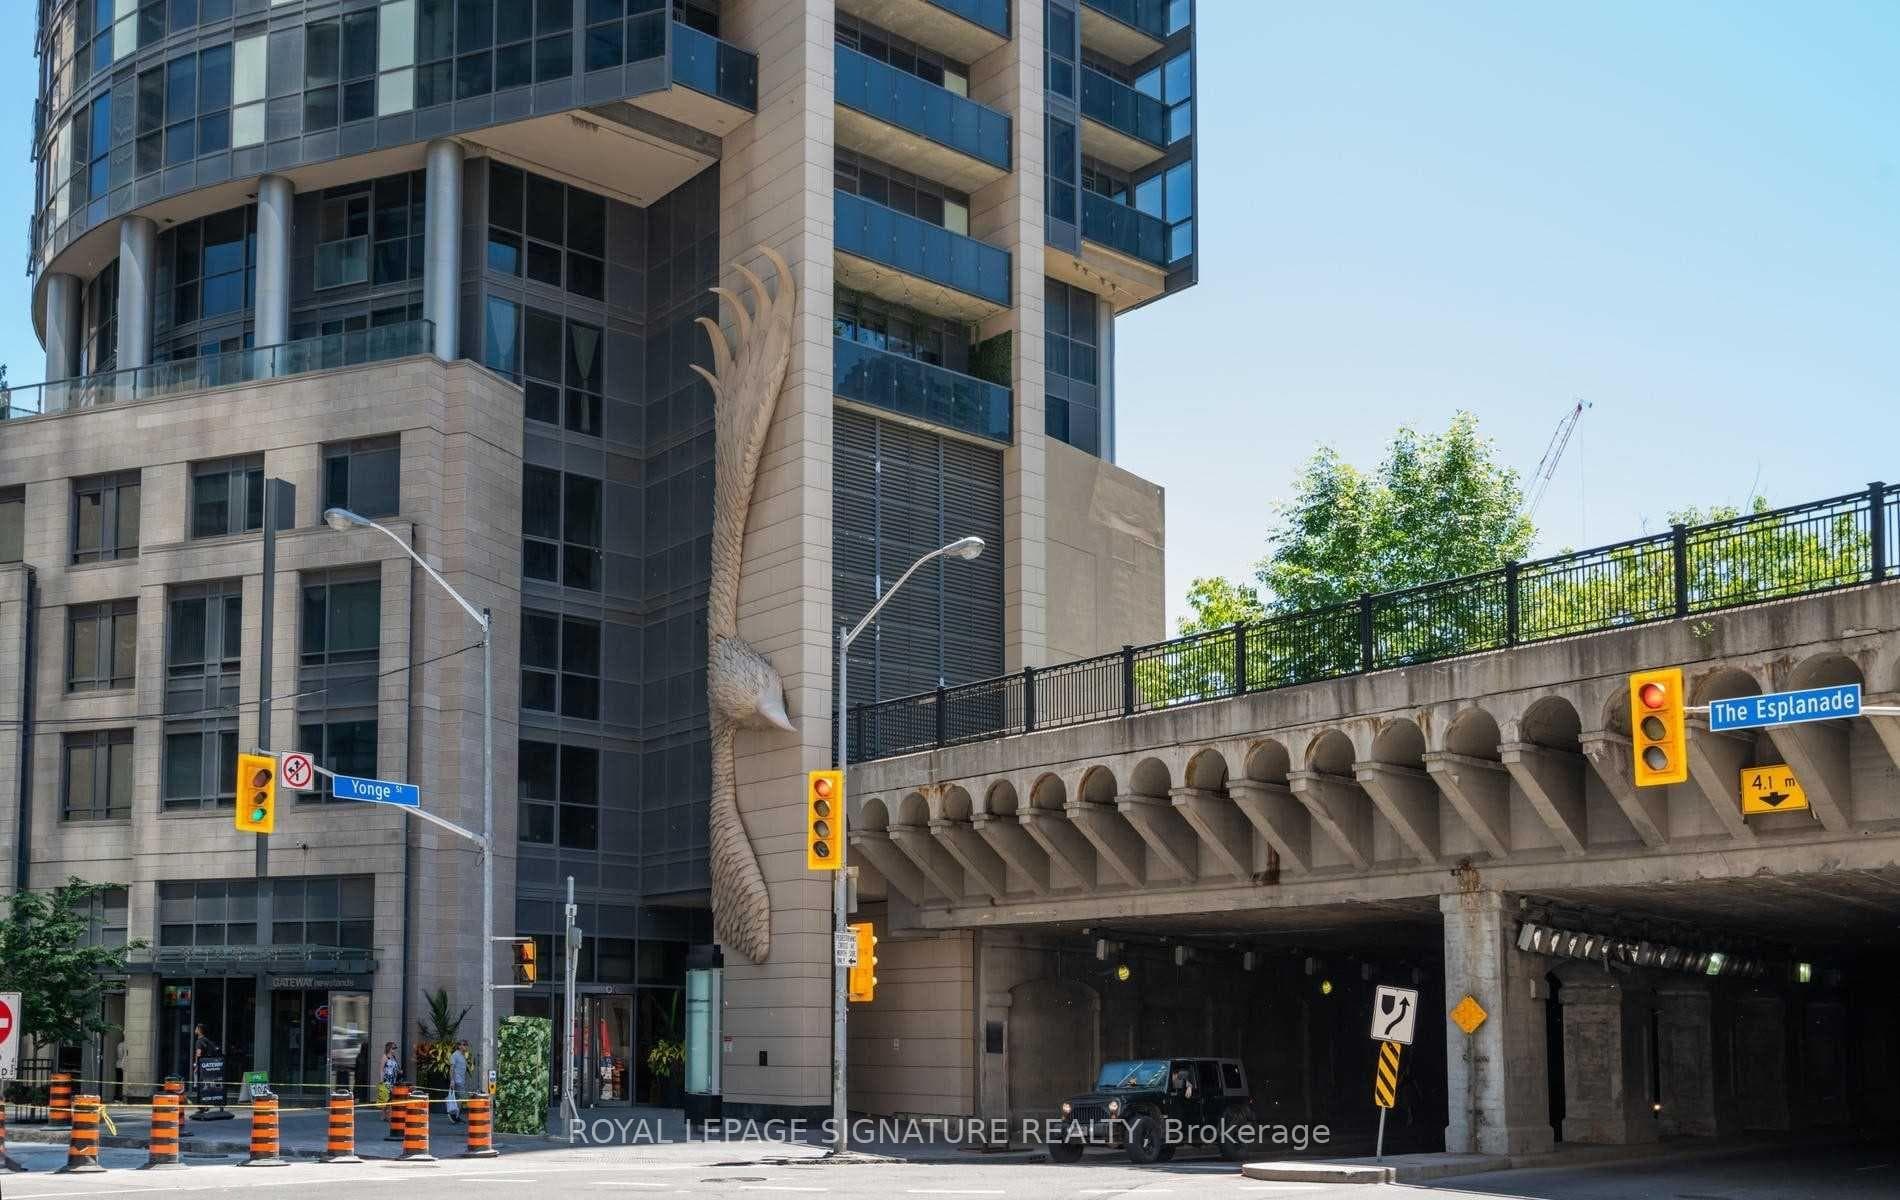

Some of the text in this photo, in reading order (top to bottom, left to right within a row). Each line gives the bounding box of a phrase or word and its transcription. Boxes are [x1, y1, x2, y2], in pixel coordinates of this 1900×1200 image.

[1715, 691, 1856, 723] The Esplanade
[351, 780, 402, 800] Yonge St
[1752, 775, 1796, 790] 4.1 m
[272, 977, 313, 987] GATEWAY
